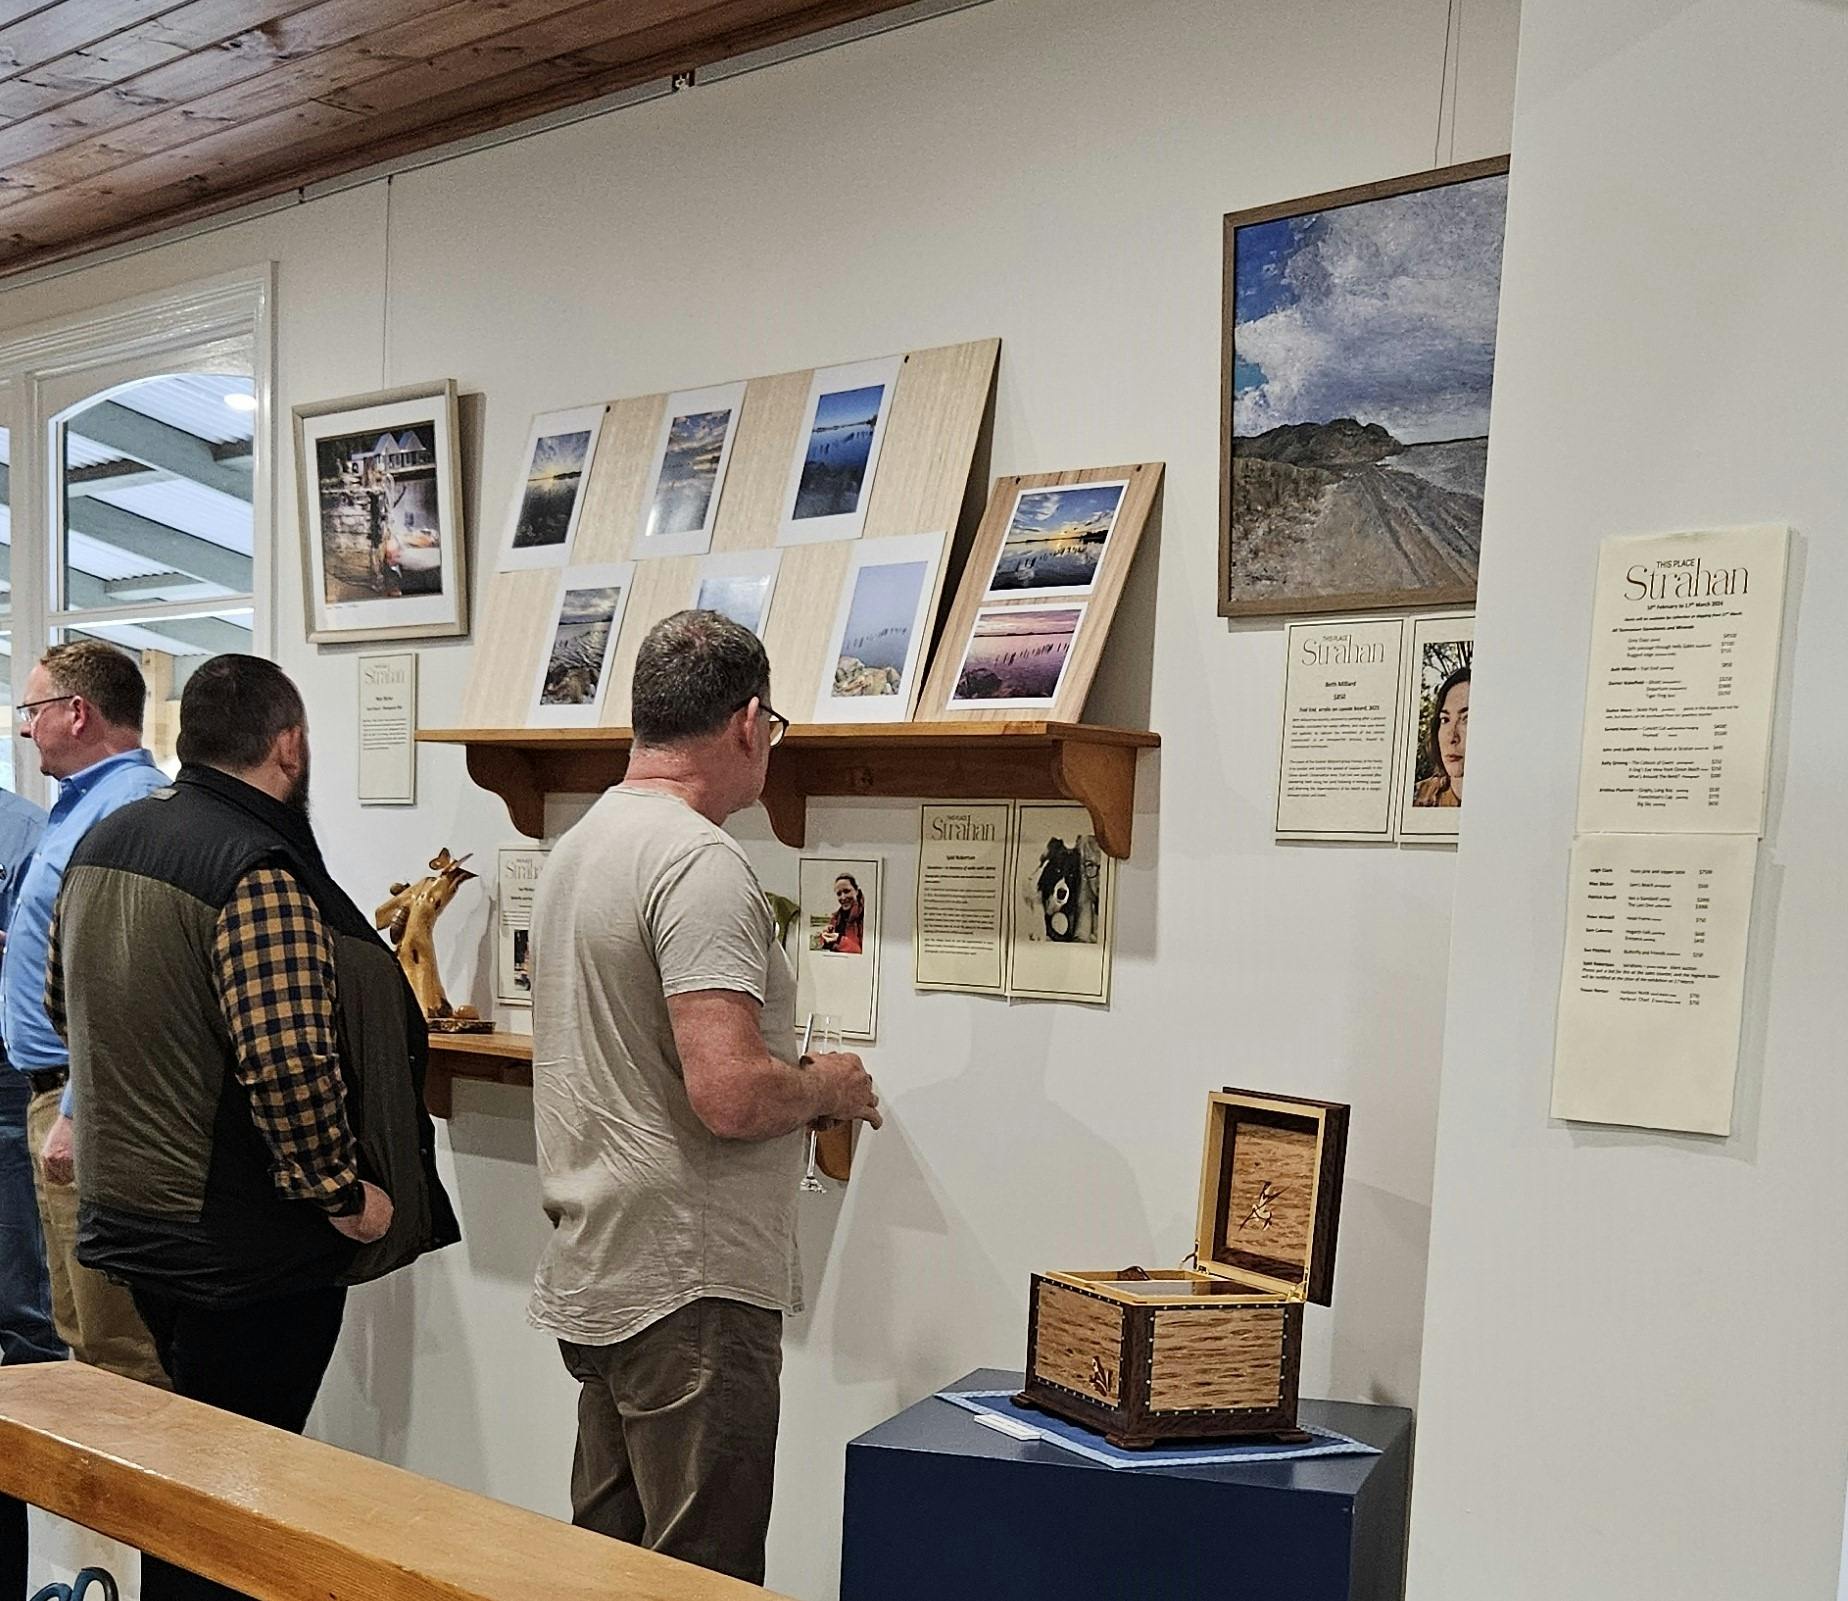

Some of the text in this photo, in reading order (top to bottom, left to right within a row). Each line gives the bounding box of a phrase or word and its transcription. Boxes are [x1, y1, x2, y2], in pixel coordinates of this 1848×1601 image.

[1673, 559, 1695, 567] PLACE
[1624, 558, 1748, 600] Strahan
[1302, 634, 1384, 666] Strahan
[932, 814, 995, 841] Strahan
